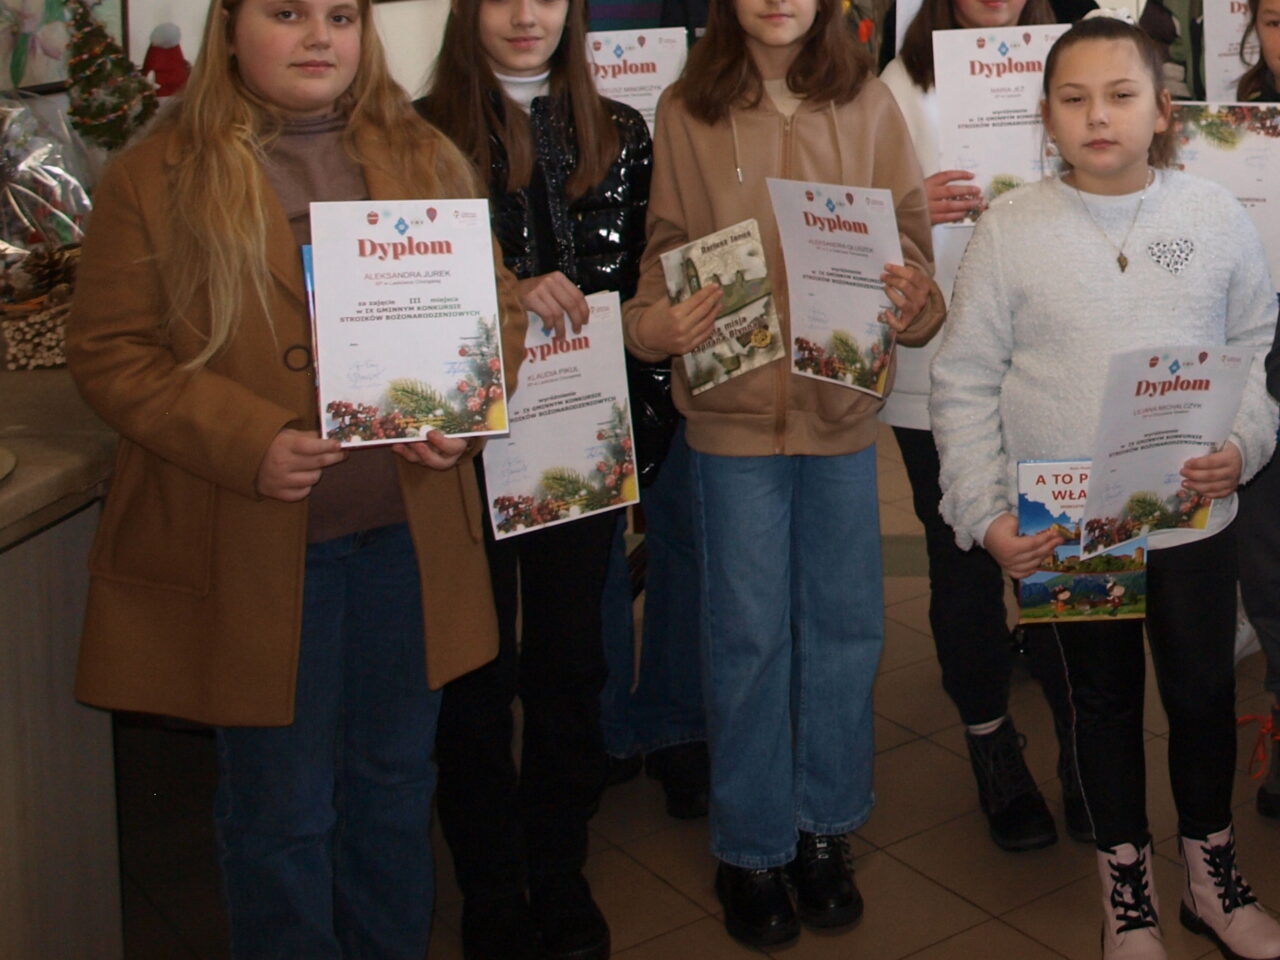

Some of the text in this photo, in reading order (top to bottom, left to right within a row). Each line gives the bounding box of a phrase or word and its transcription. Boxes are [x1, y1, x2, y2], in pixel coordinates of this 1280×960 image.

[1230, 1, 1249, 15] Dy
[969, 57, 1043, 78] Dyplom
[803, 211, 869, 235] Dyplom
[357, 236, 453, 261] Dyplom
[364, 271, 422, 280] ALEKSANDRA
[1135, 375, 1211, 397] Dyplom
[1035, 473, 1088, 485] A TO P
[1052, 489, 1087, 500] WŁA
